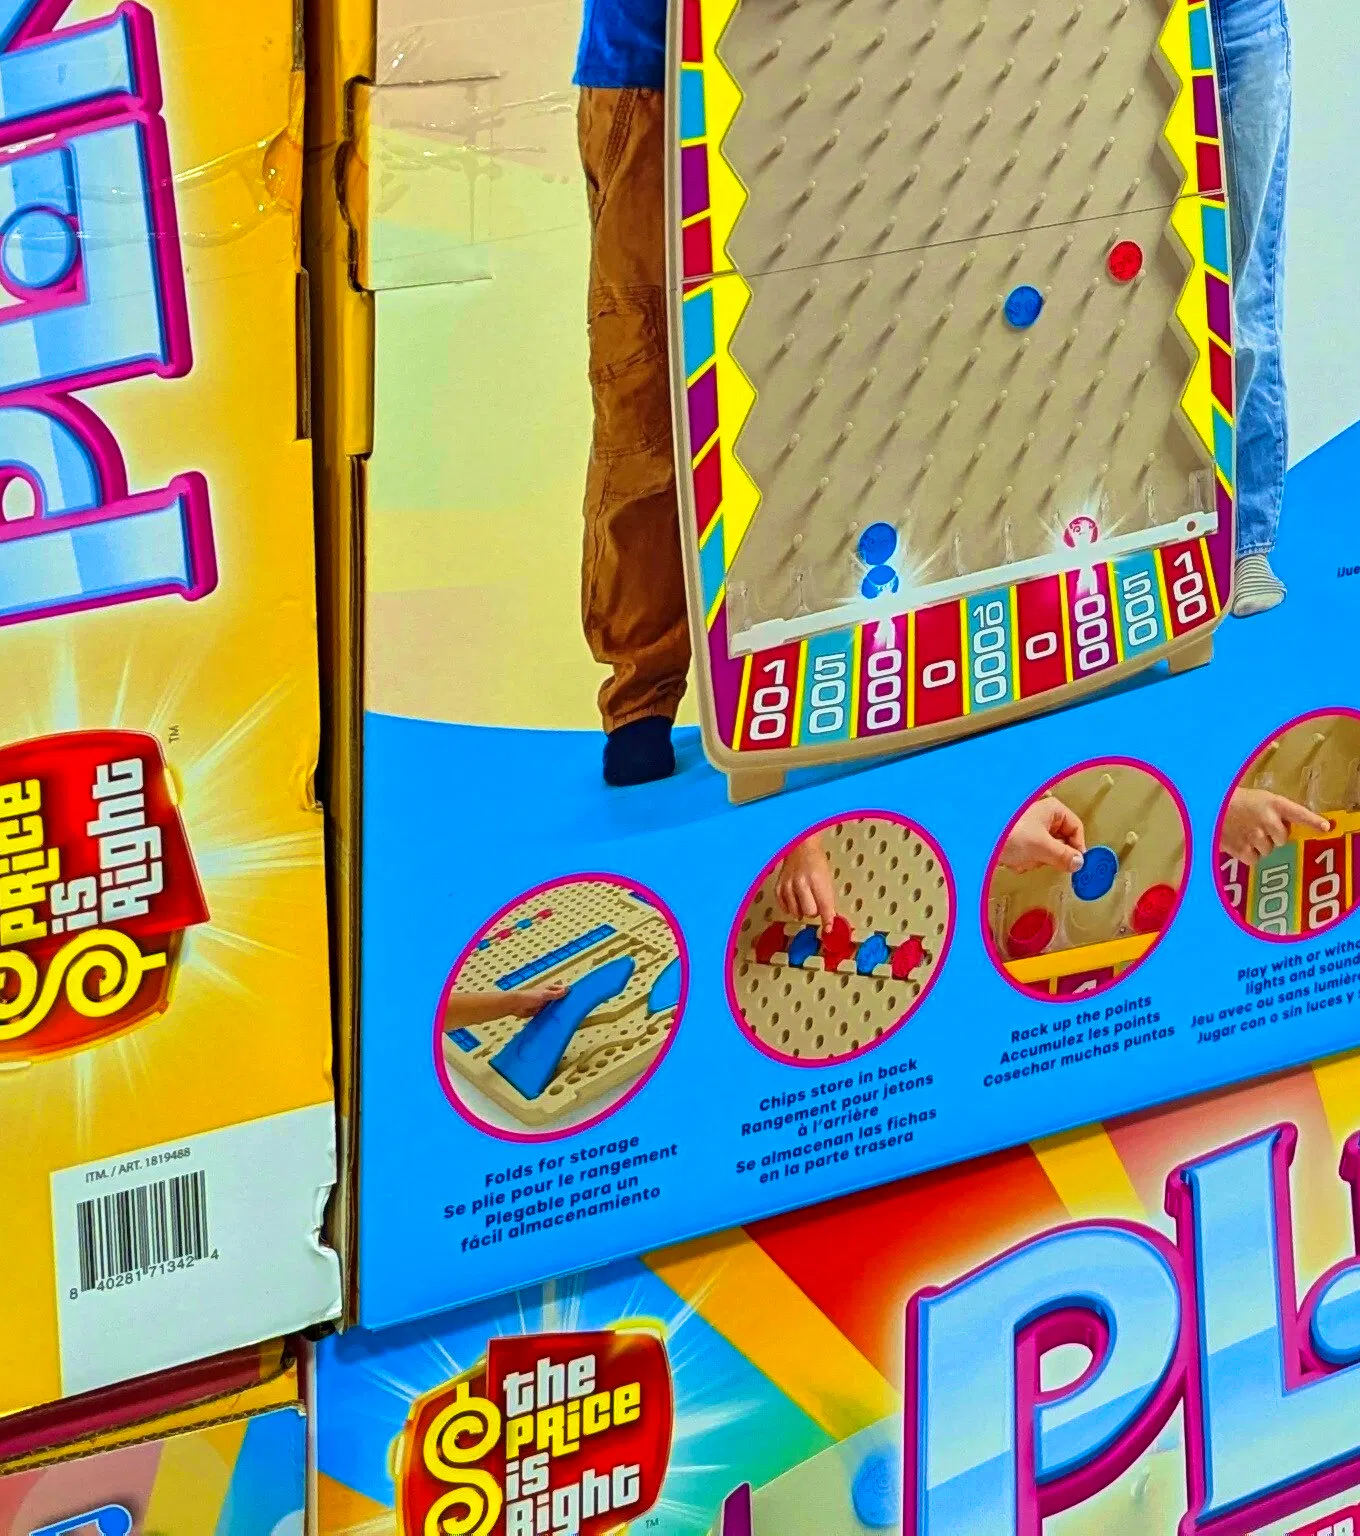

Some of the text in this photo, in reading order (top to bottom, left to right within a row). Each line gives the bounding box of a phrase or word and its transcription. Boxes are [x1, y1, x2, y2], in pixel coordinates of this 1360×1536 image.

[87, 757, 166, 924] Right
[51, 875, 98, 935] is
[1237, 966, 1267, 983] Play
[1271, 954, 1302, 972] with
[1306, 950, 1321, 963] or
[1245, 974, 1286, 996] lights
[1289, 966, 1316, 983] and
[1011, 994, 1152, 1044] Rack up the points
[1190, 1012, 1215, 1028] Jeu
[1218, 1002, 1253, 1020] avec
[1256, 996, 1274, 1009] ou
[1277, 986, 1310, 1004] sans
[983, 1024, 1176, 1088] Cosechar muchas puntas
[1000, 1011, 1161, 1065] Accumulez les points
[741, 1073, 934, 1136] Rangement pour jetons
[759, 1058, 918, 1112] Chips store in back
[736, 1107, 937, 1174] Se almacenan las fichas
[797, 1122, 808, 1137] à
[444, 1143, 678, 1219] Se plie pour le rangement
[485, 1135, 639, 1188] Folds for storage
[759, 1131, 913, 1184] en la parte trasera
[570, 1183, 611, 1206] para
[617, 1175, 639, 1192] un
[460, 1185, 661, 1252] fácil almacenamiento
